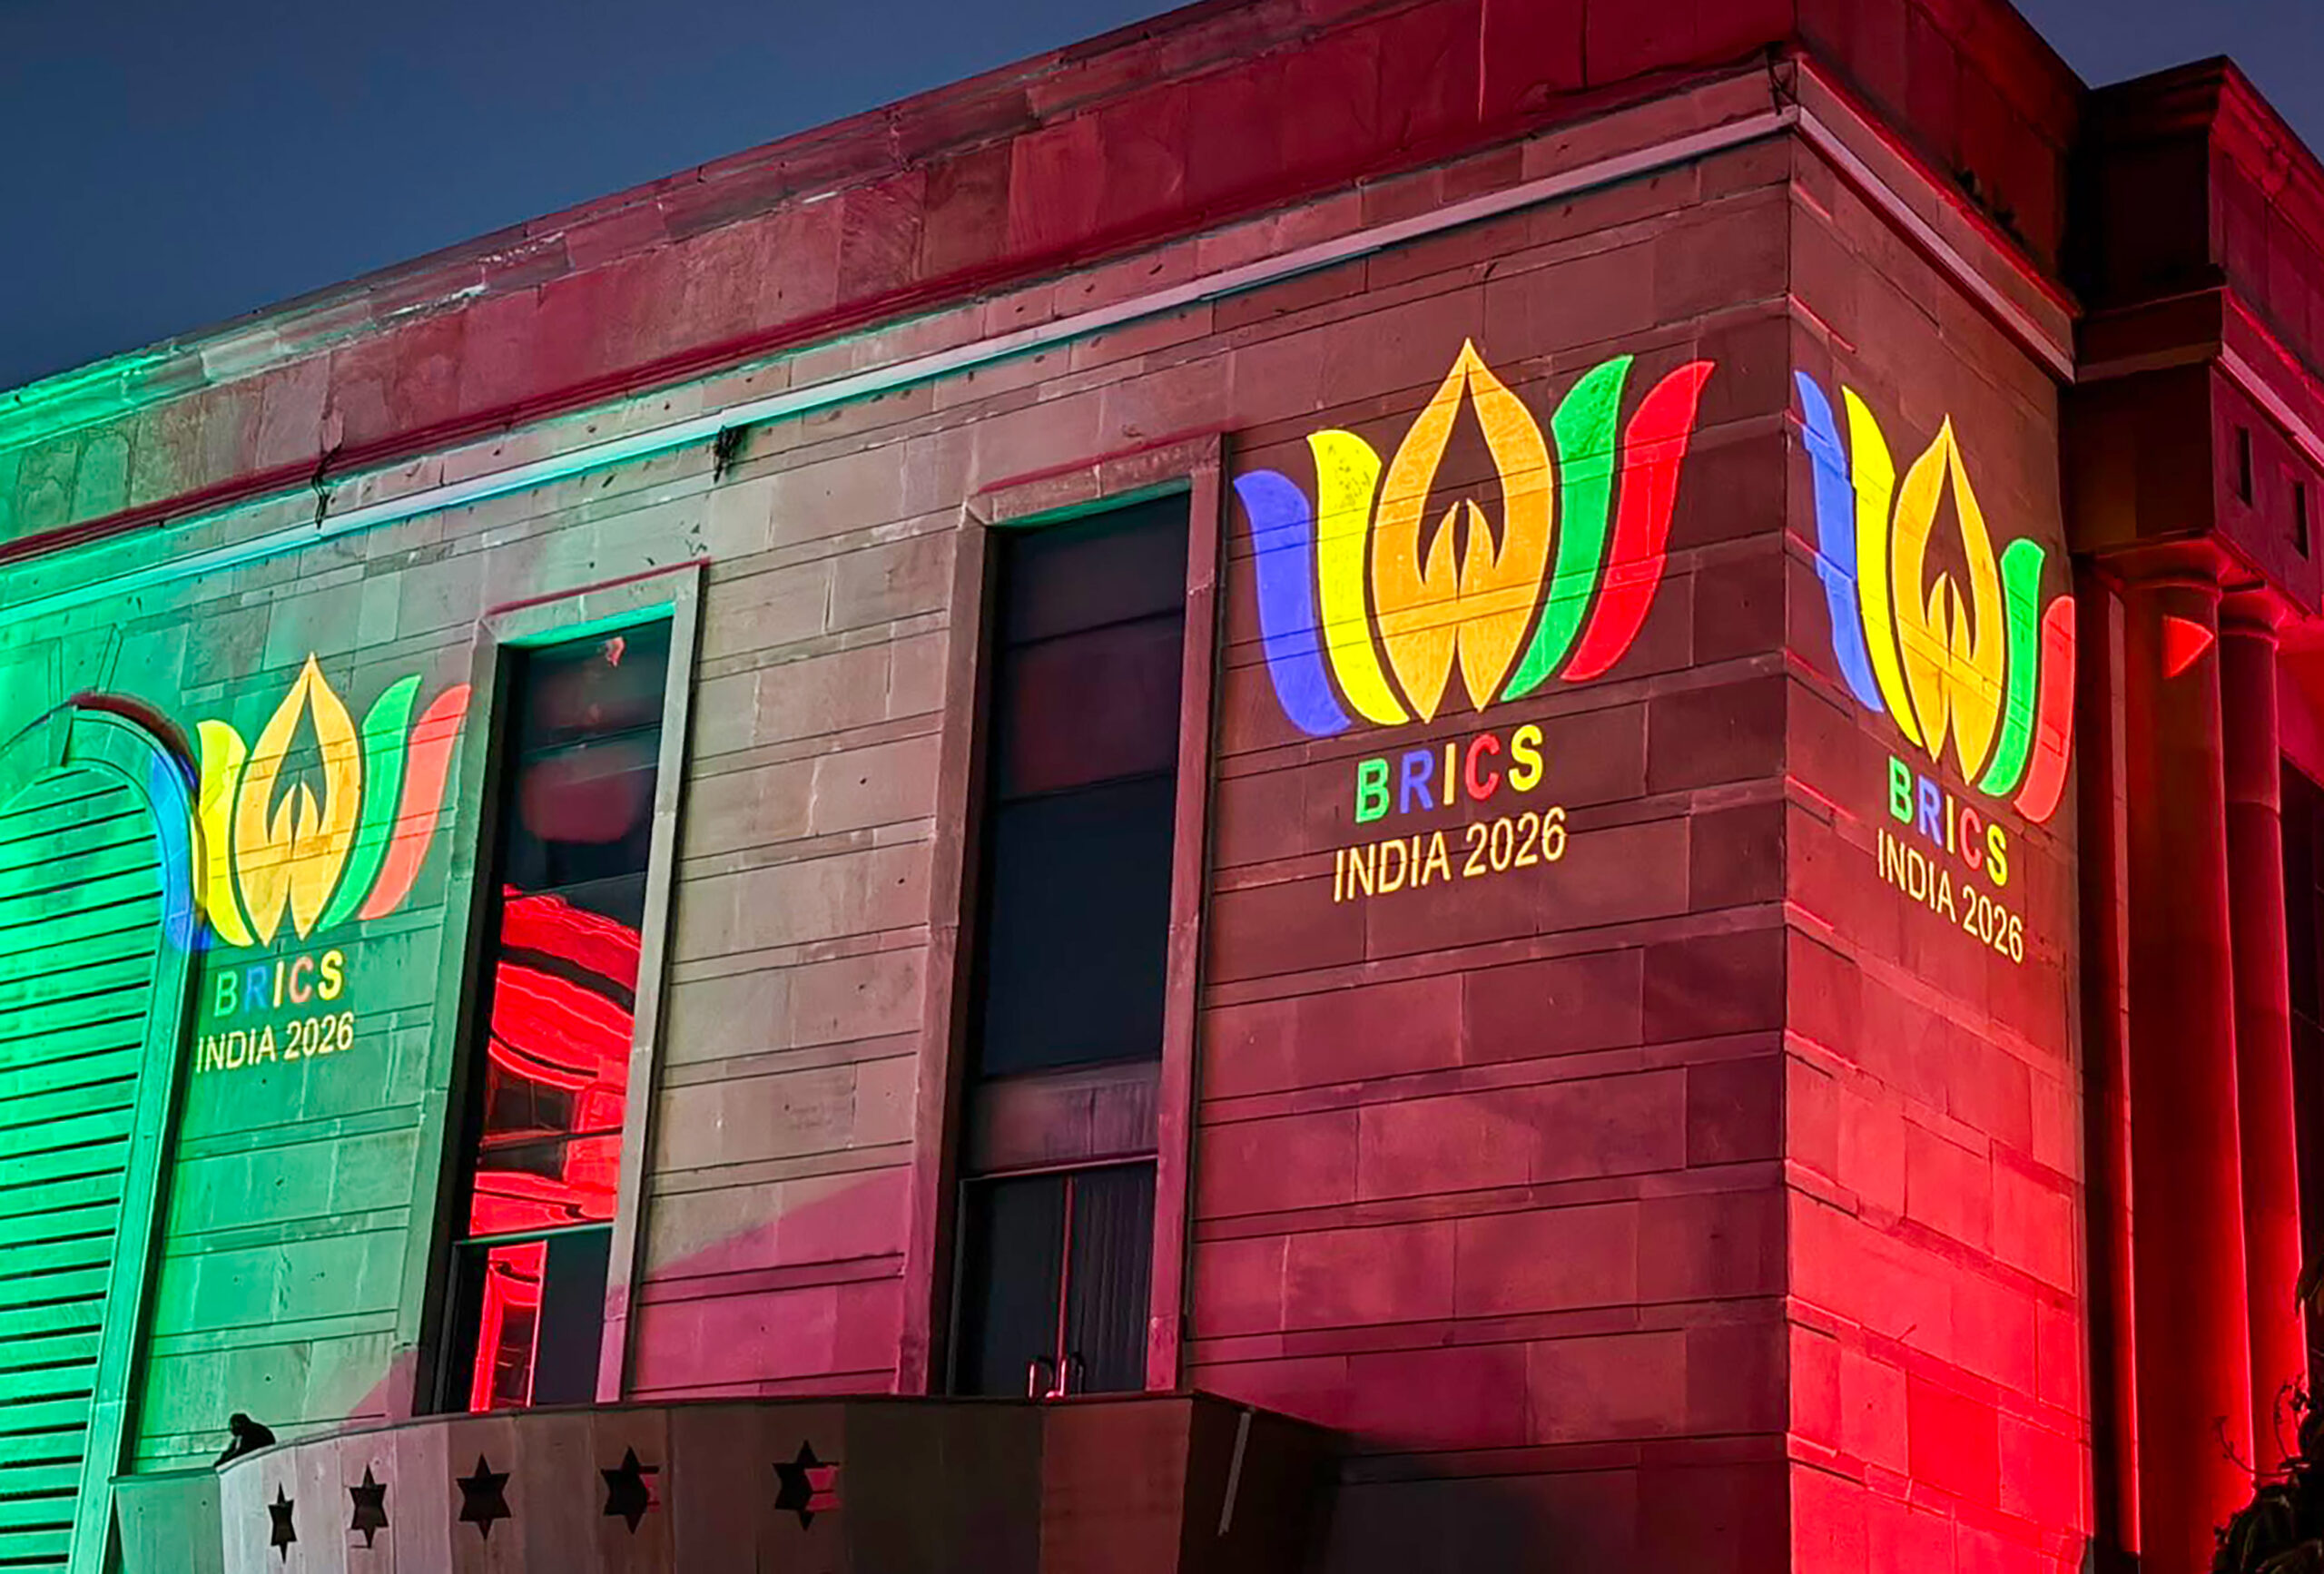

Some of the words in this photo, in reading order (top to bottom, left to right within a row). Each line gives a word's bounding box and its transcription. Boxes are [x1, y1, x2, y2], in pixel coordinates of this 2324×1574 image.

[1355, 724, 1543, 823] BRICS
[1889, 754, 2008, 886] BRICS
[1334, 831, 1451, 902] INDIA
[1462, 806, 1566, 878] 2026
[1877, 827, 1956, 923] INDIA
[1963, 884, 2023, 964] 2026
[213, 949, 343, 1018] BRICS
[196, 1024, 277, 1074] INDIA
[283, 1010, 355, 1060] 2026
